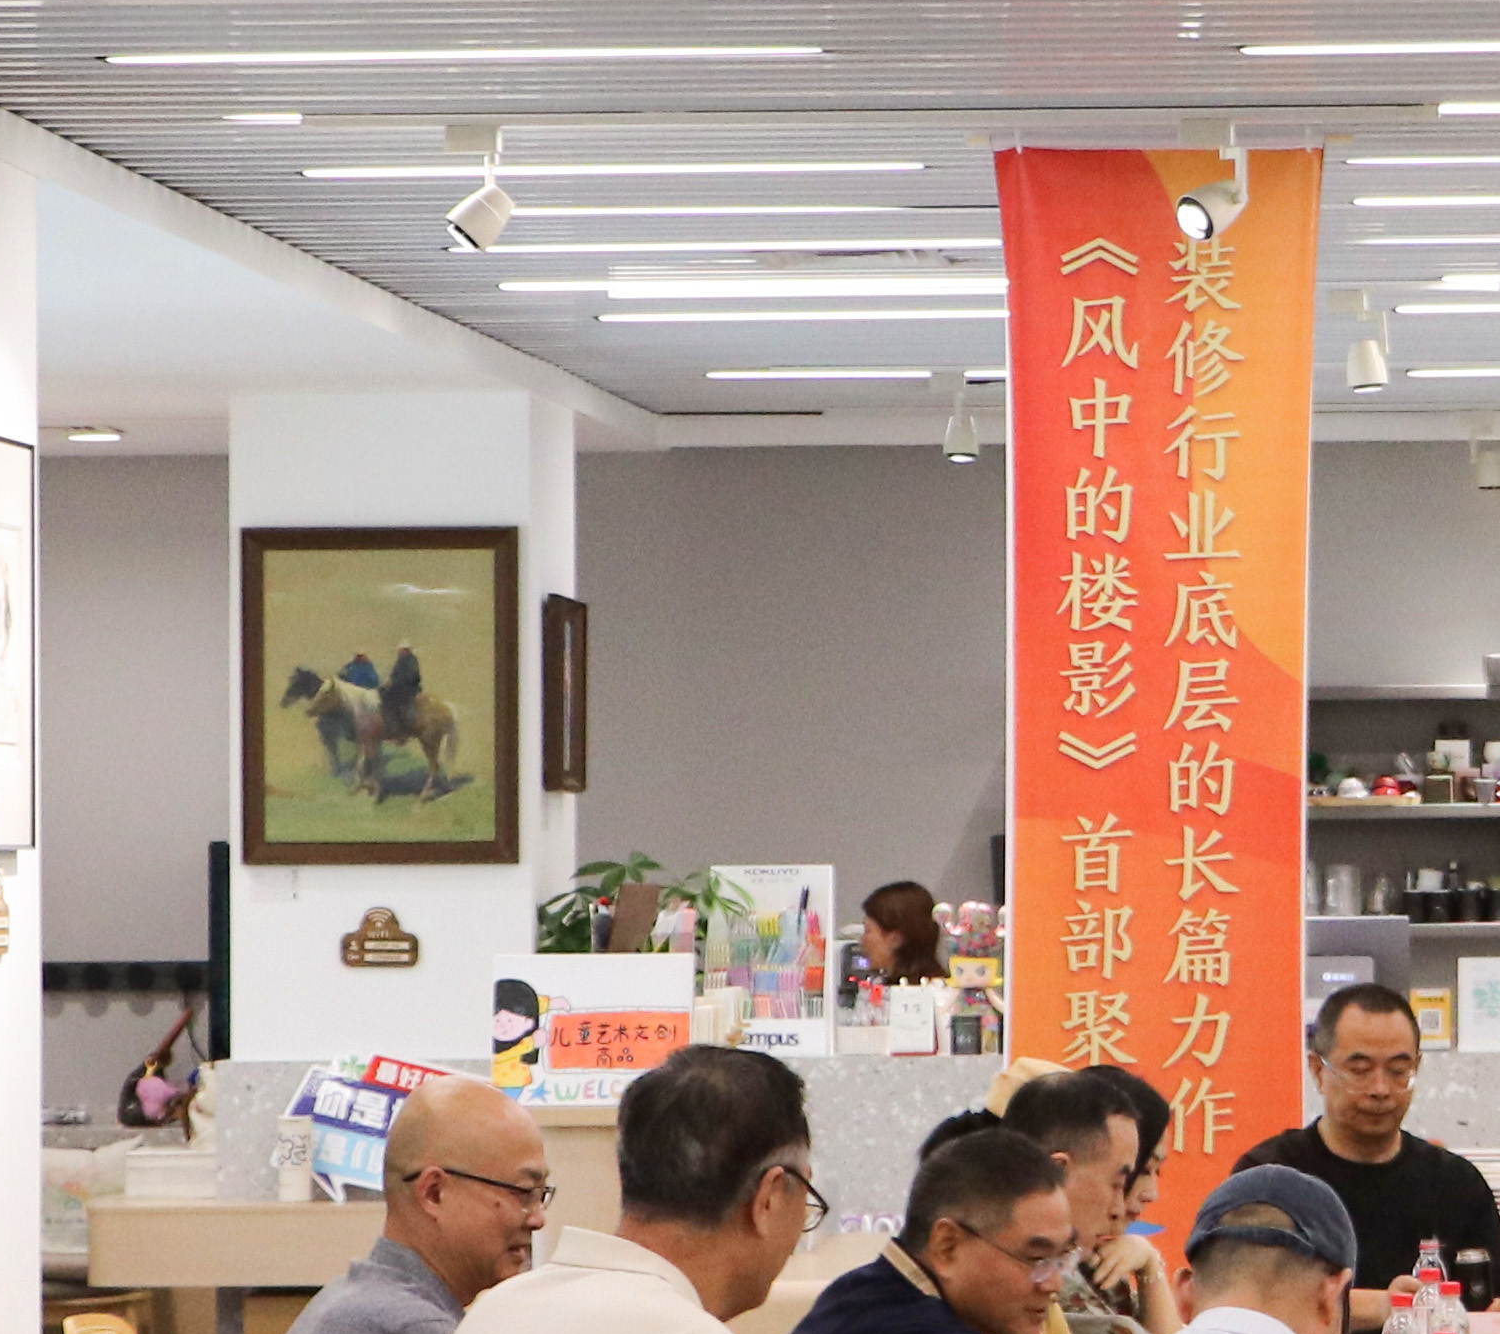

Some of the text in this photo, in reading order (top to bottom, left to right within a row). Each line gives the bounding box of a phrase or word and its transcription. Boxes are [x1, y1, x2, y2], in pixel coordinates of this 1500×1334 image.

[1056, 236, 1141, 1067] 《风中的楼影》 首部聚
[1161, 237, 1244, 1155] 装修行业底层的长篇力作
[550, 1021, 677, 1047] 儿童艺术文创
[744, 1031, 799, 1048] ampus
[553, 1079, 624, 1101] WELC
